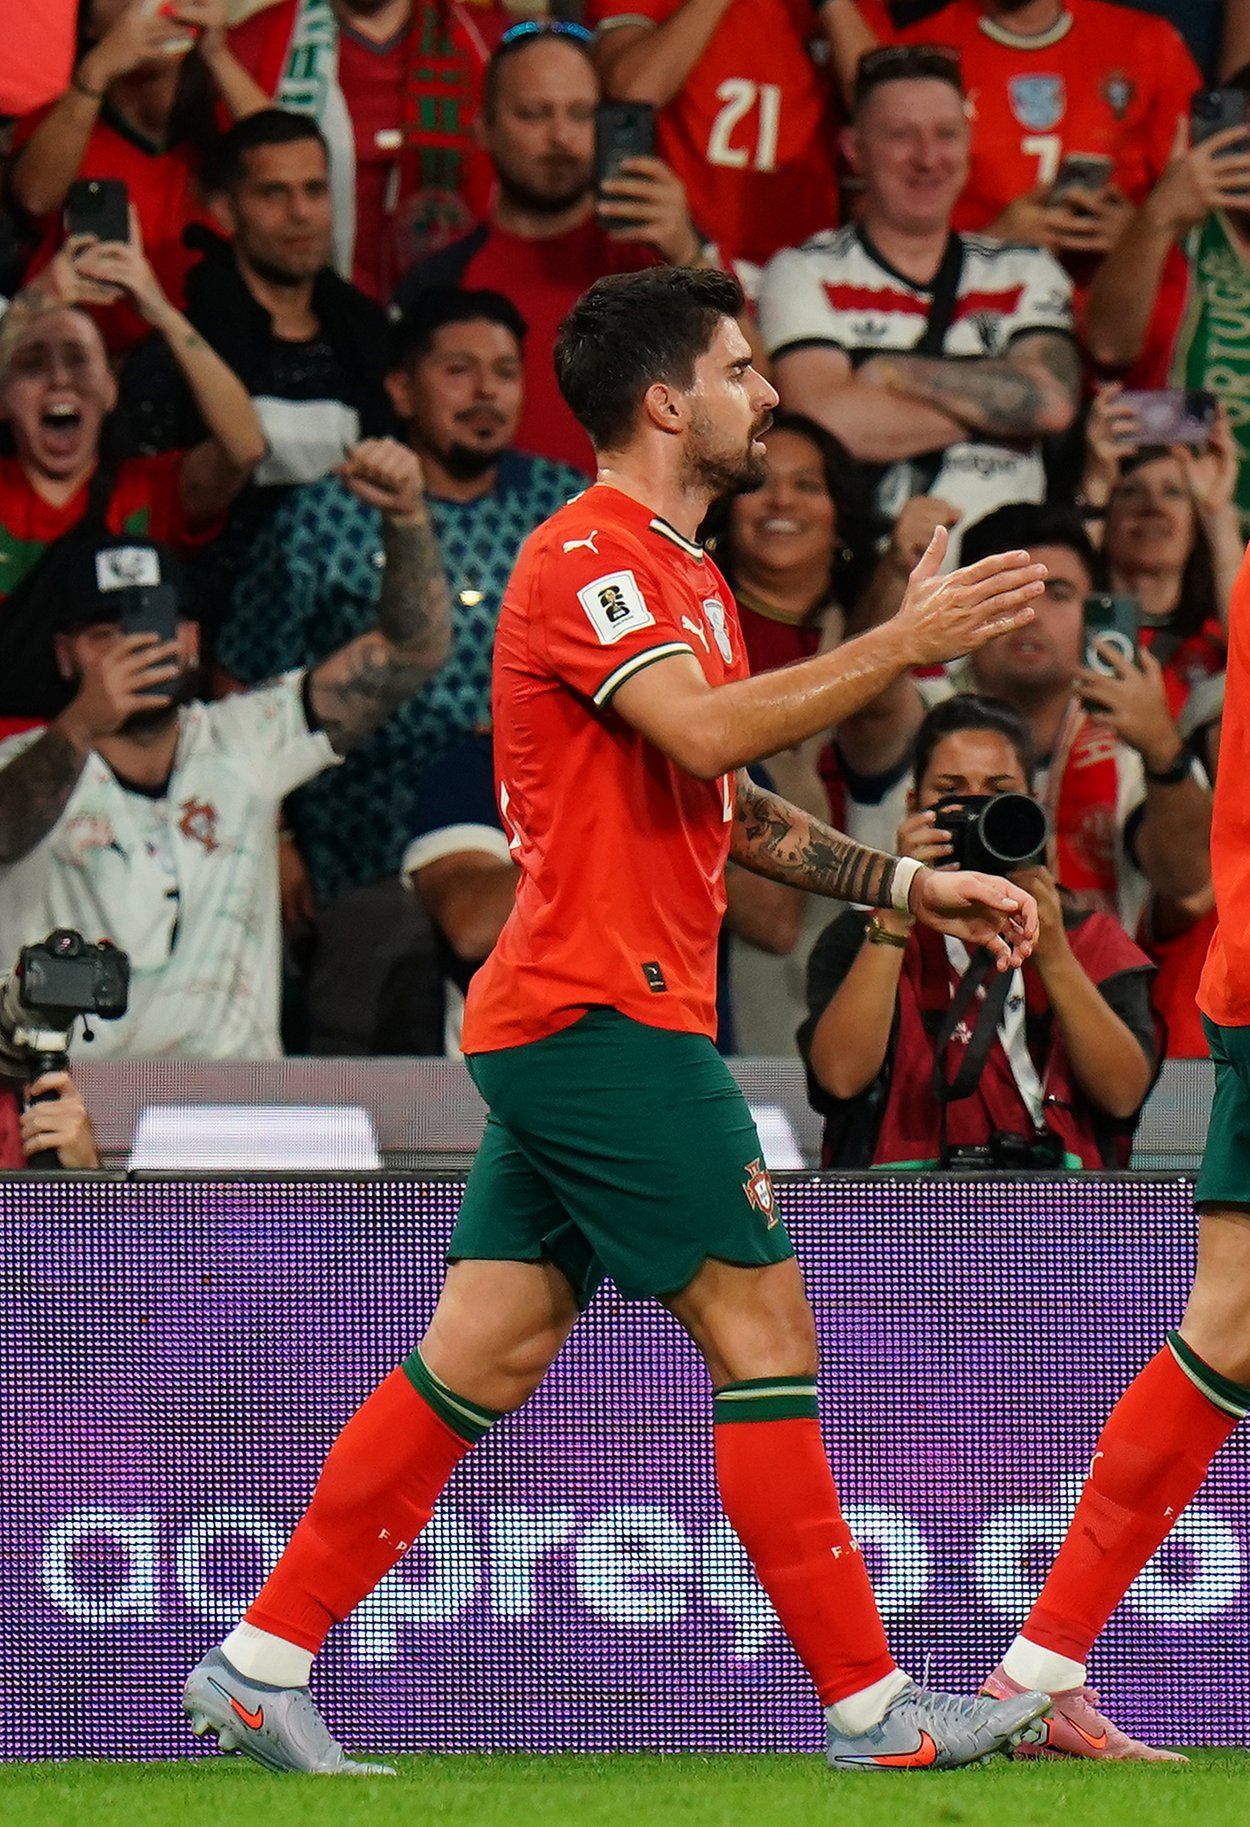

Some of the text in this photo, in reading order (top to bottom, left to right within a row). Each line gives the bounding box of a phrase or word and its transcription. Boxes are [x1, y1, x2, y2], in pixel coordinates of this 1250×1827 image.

[706, 77, 781, 172] 21
[1021, 134, 1061, 186] 7
[40, 1505, 292, 1622] ao
[974, 1472, 1242, 1623] do
